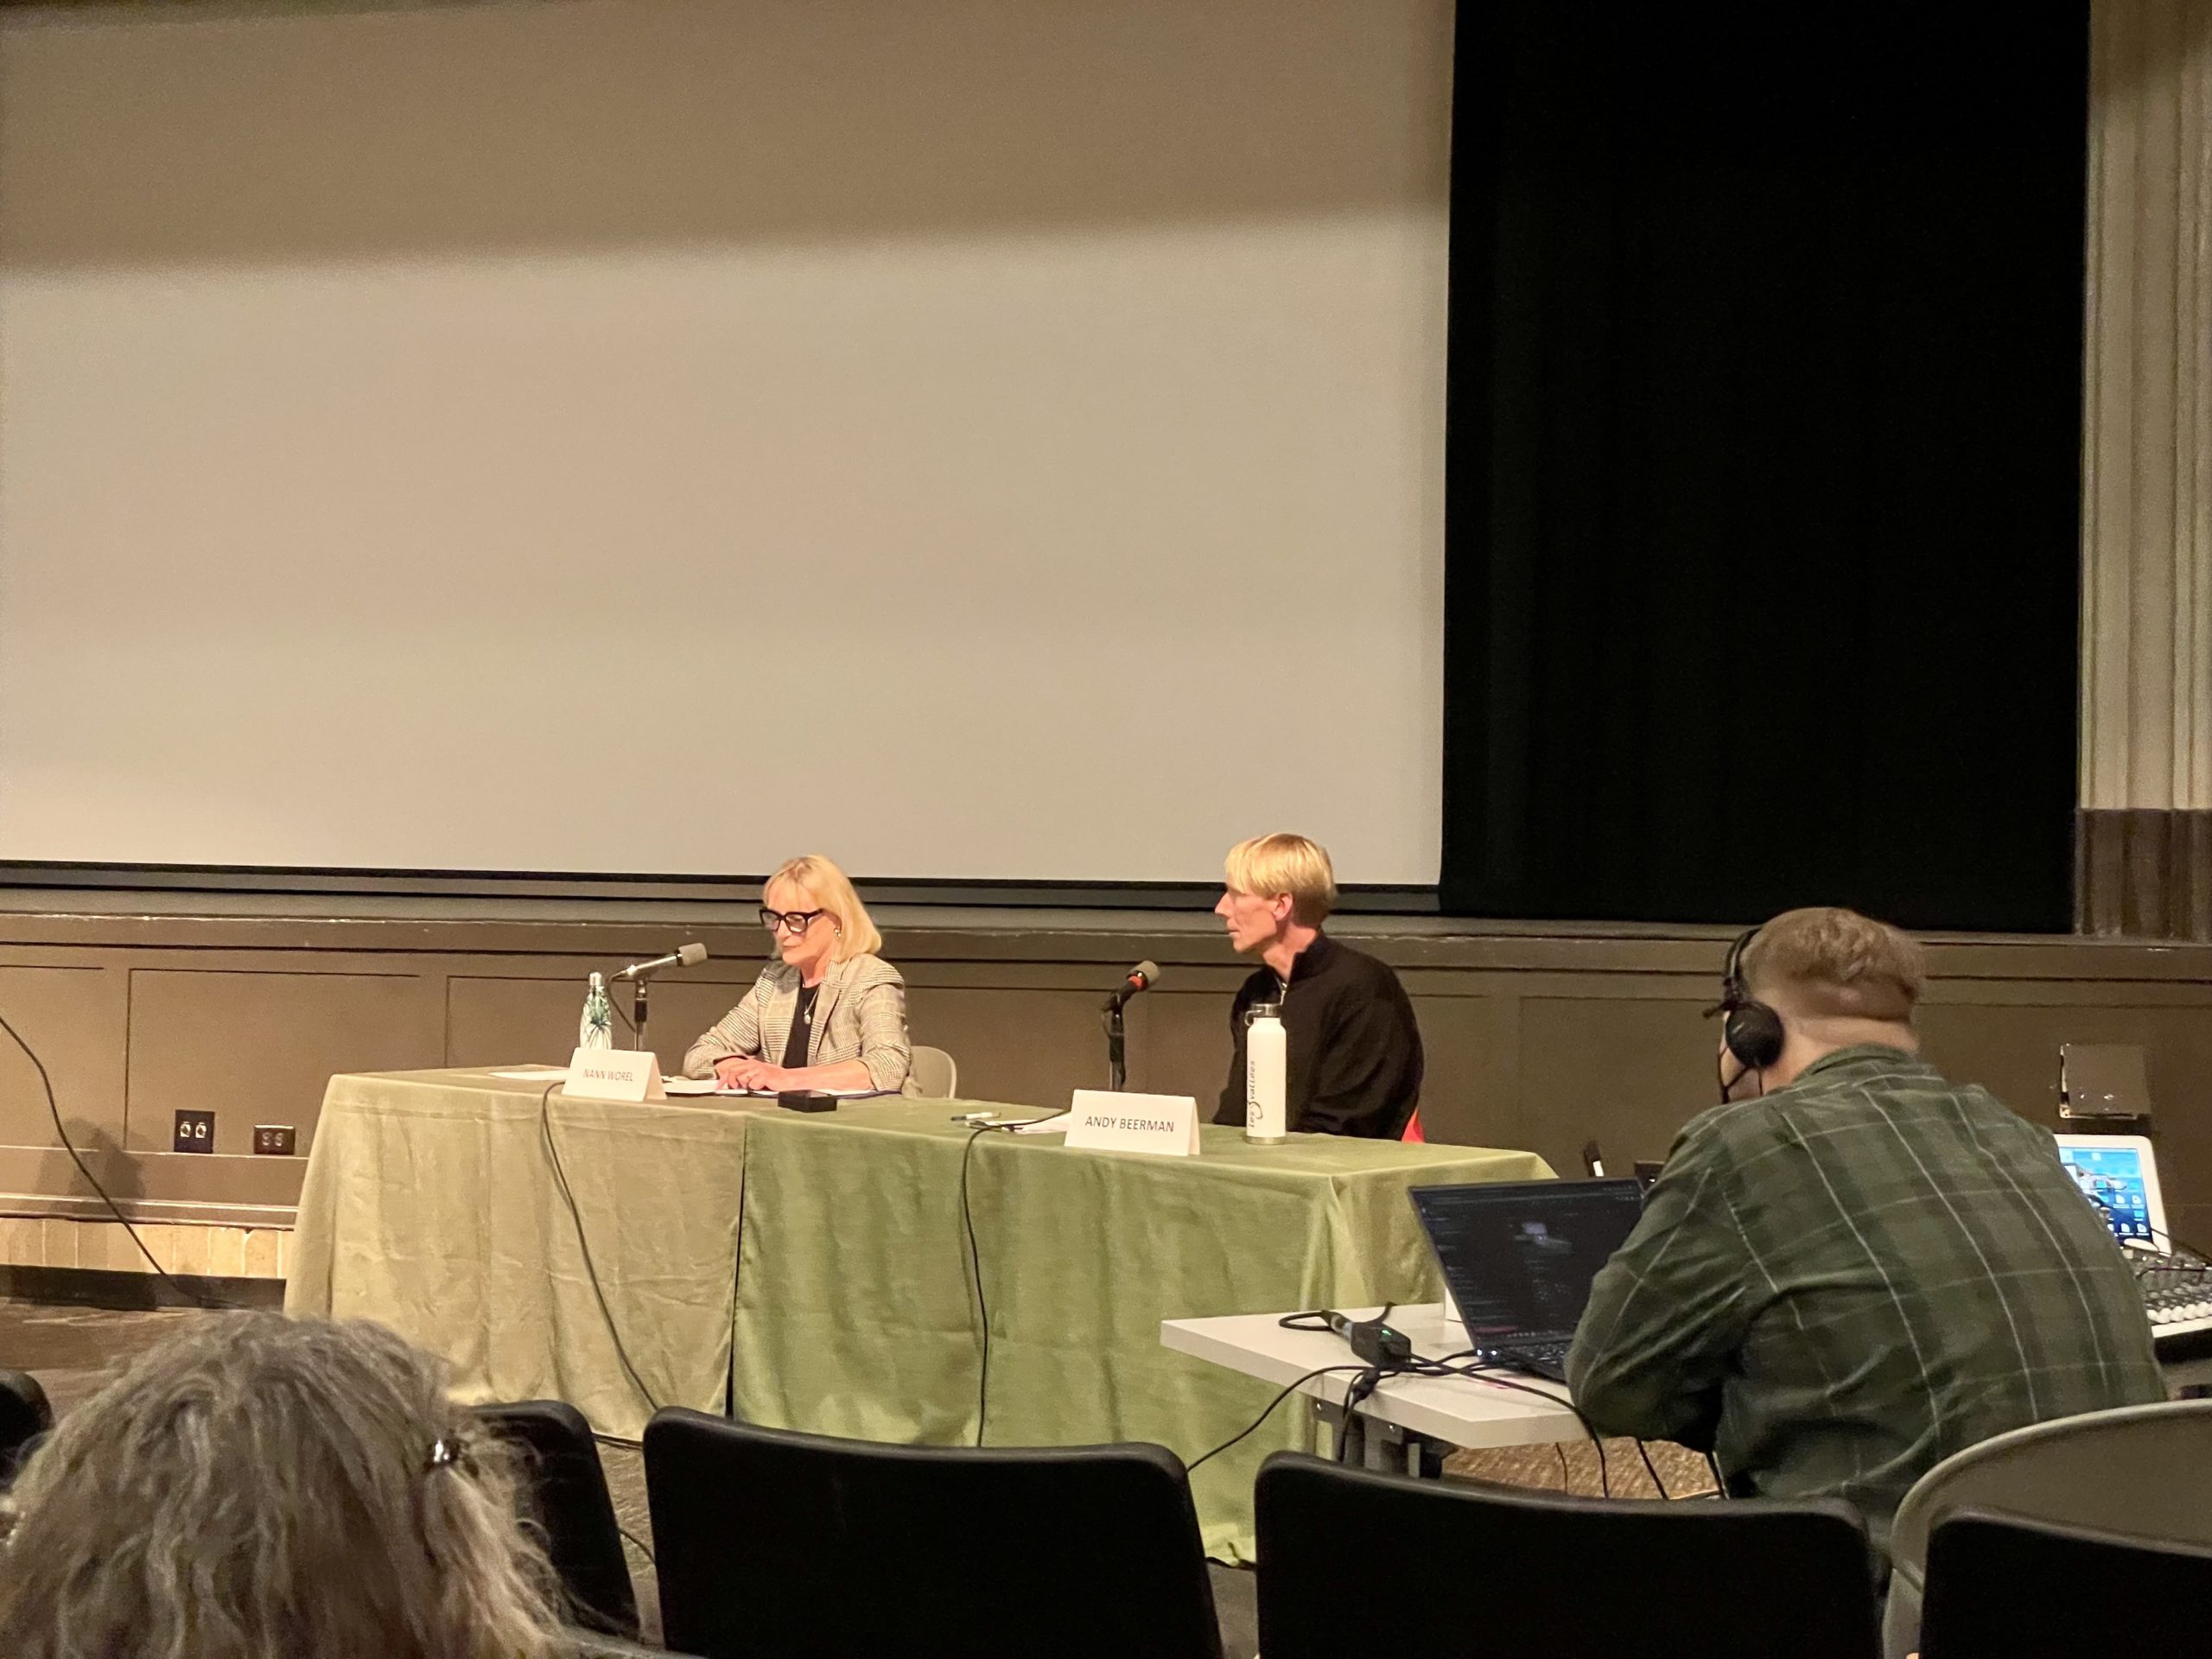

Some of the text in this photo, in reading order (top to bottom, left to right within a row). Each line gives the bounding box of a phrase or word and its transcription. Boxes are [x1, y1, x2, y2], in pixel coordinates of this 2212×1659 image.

[583, 1069, 606, 1079] NANN
[1085, 1116, 1174, 1133] ANDY BEERMAN
